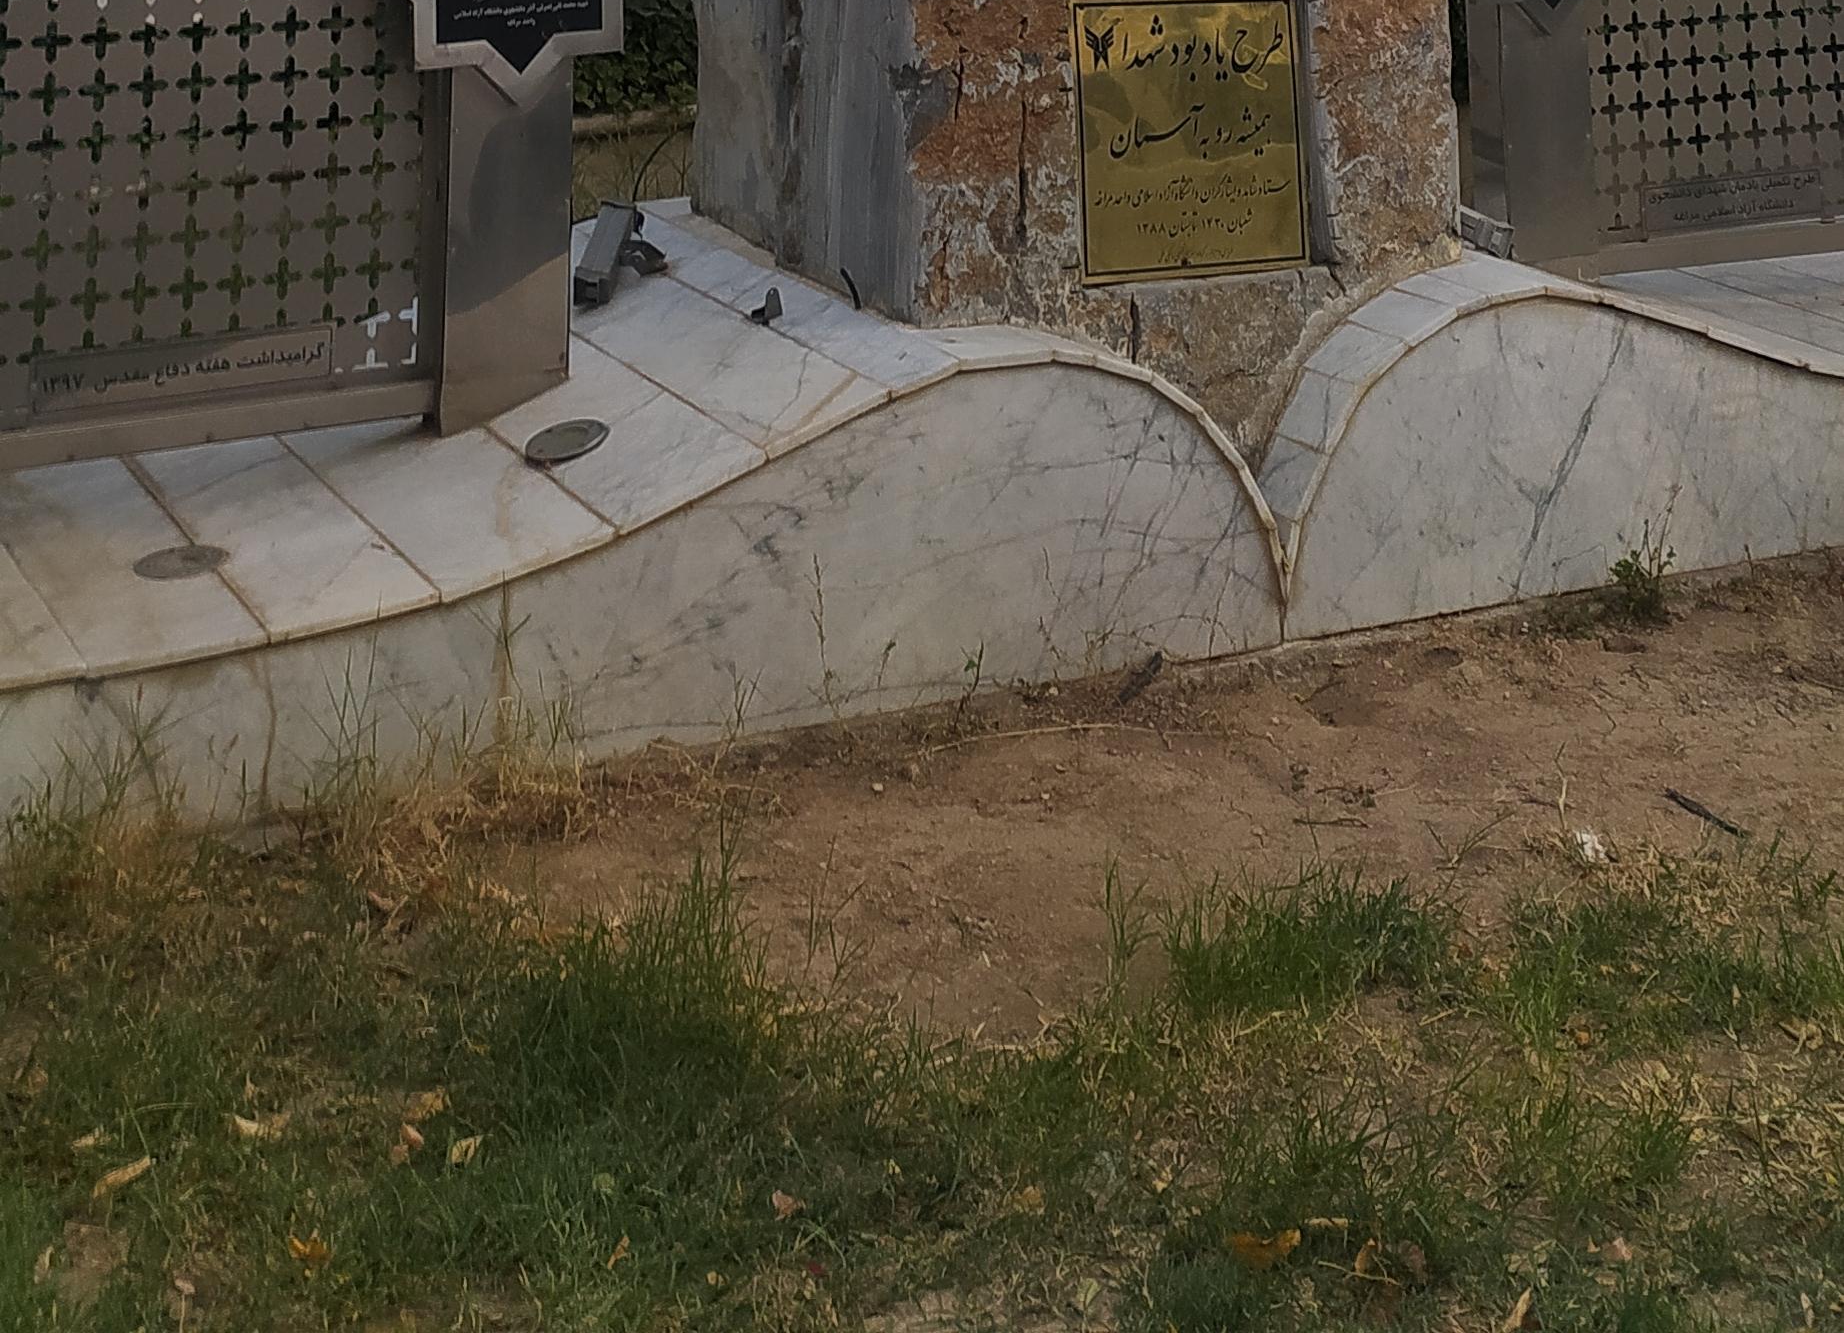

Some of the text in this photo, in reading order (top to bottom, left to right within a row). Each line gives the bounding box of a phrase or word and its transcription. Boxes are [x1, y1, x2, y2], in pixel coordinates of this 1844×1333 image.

[1121, 14, 1166, 70] شهدا
[1231, 20, 1284, 75] طرح
[1109, 102, 1271, 160] همیشه رو به آسمان
[1094, 190, 1113, 208] مراغه
[1113, 190, 1131, 205] واحد
[1131, 188, 1158, 208] اسلامی
[1174, 174, 1199, 201] دانشگاه
[1199, 172, 1237, 204] ایثارگران
[1242, 174, 1258, 198] شاهد
[1258, 178, 1291, 195] ستاد
[1648, 174, 1816, 205] طرح تکمیلی یادمان شهدای دانشجوی
[1226, 207, 1252, 235] شعبان
[1672, 198, 1794, 222] دانشگاه آزاد اسلامی مراغه
[1136, 222, 1166, 235] ۱۳۸۸
[1168, 210, 1198, 238] تابستان
[41, 341, 325, 393] گرامیداشت هفته دفاع مقدس ۱۳۹۷
